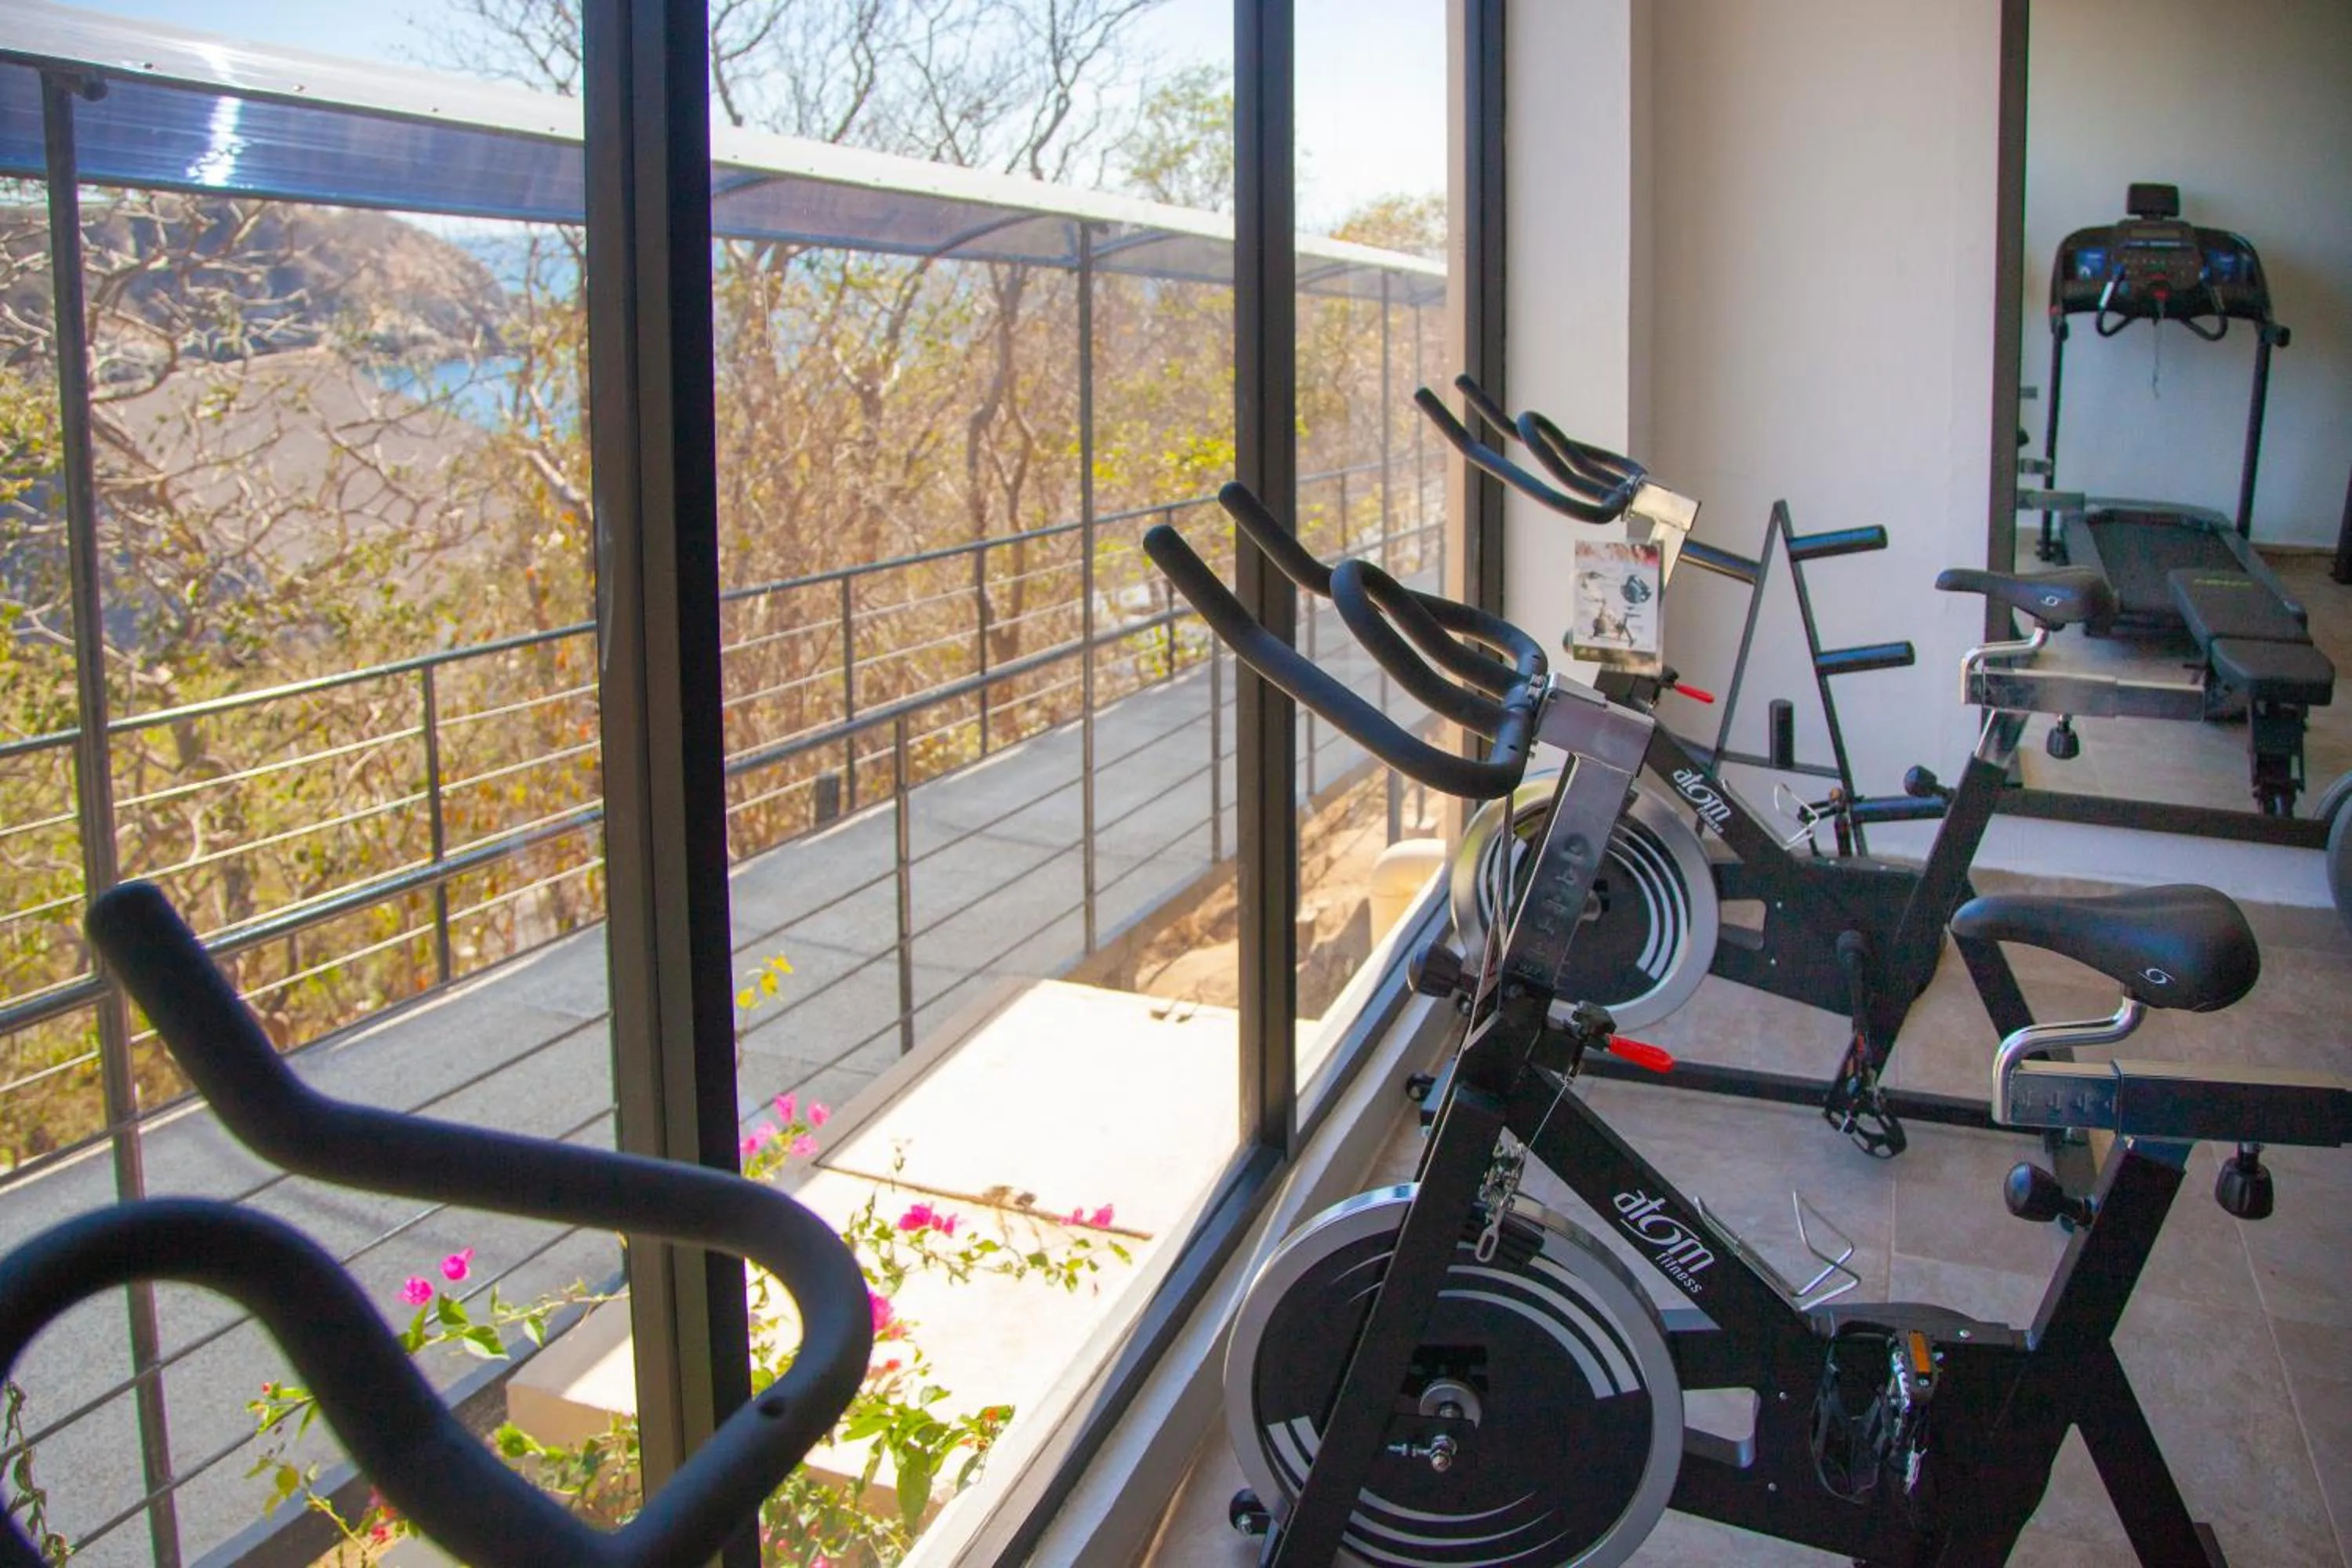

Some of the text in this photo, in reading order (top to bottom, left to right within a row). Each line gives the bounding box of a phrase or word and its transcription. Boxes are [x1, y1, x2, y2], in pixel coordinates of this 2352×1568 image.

[1673, 768, 1731, 821] atom
[1613, 1189, 1715, 1273] atom
[1655, 1252, 1702, 1294] fitness
